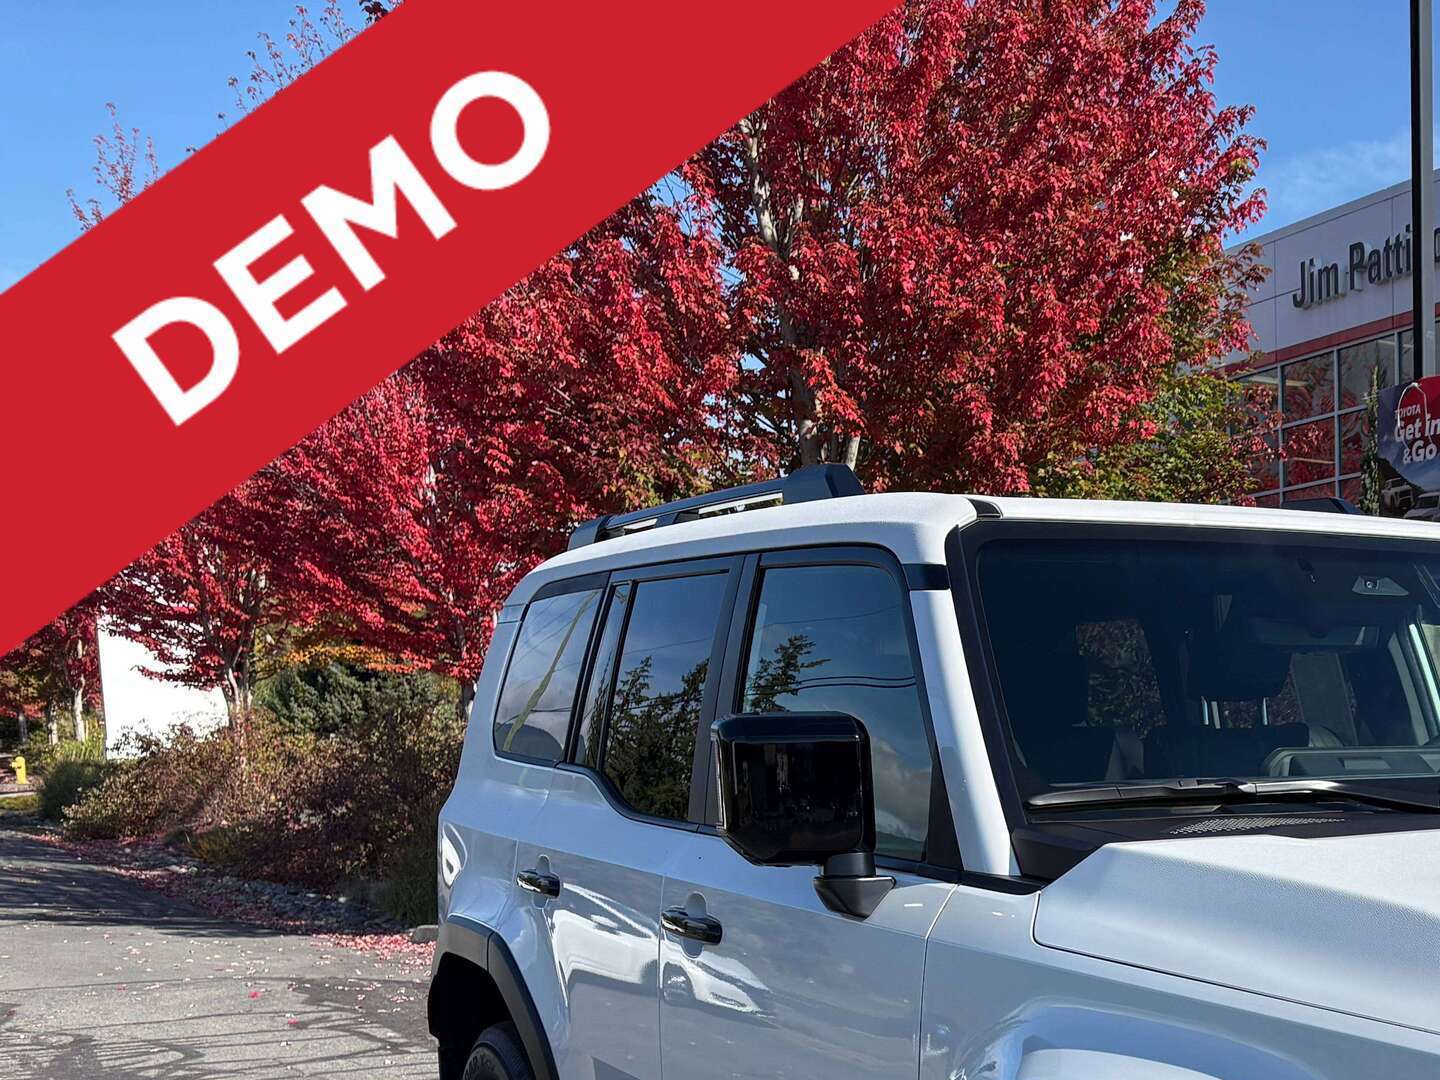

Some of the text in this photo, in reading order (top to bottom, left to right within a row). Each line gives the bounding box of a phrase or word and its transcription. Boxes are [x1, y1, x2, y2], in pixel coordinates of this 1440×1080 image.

[1293, 257, 1340, 309] Jim
[1394, 418, 1422, 442] Get
[1402, 440, 1437, 464] &Go
